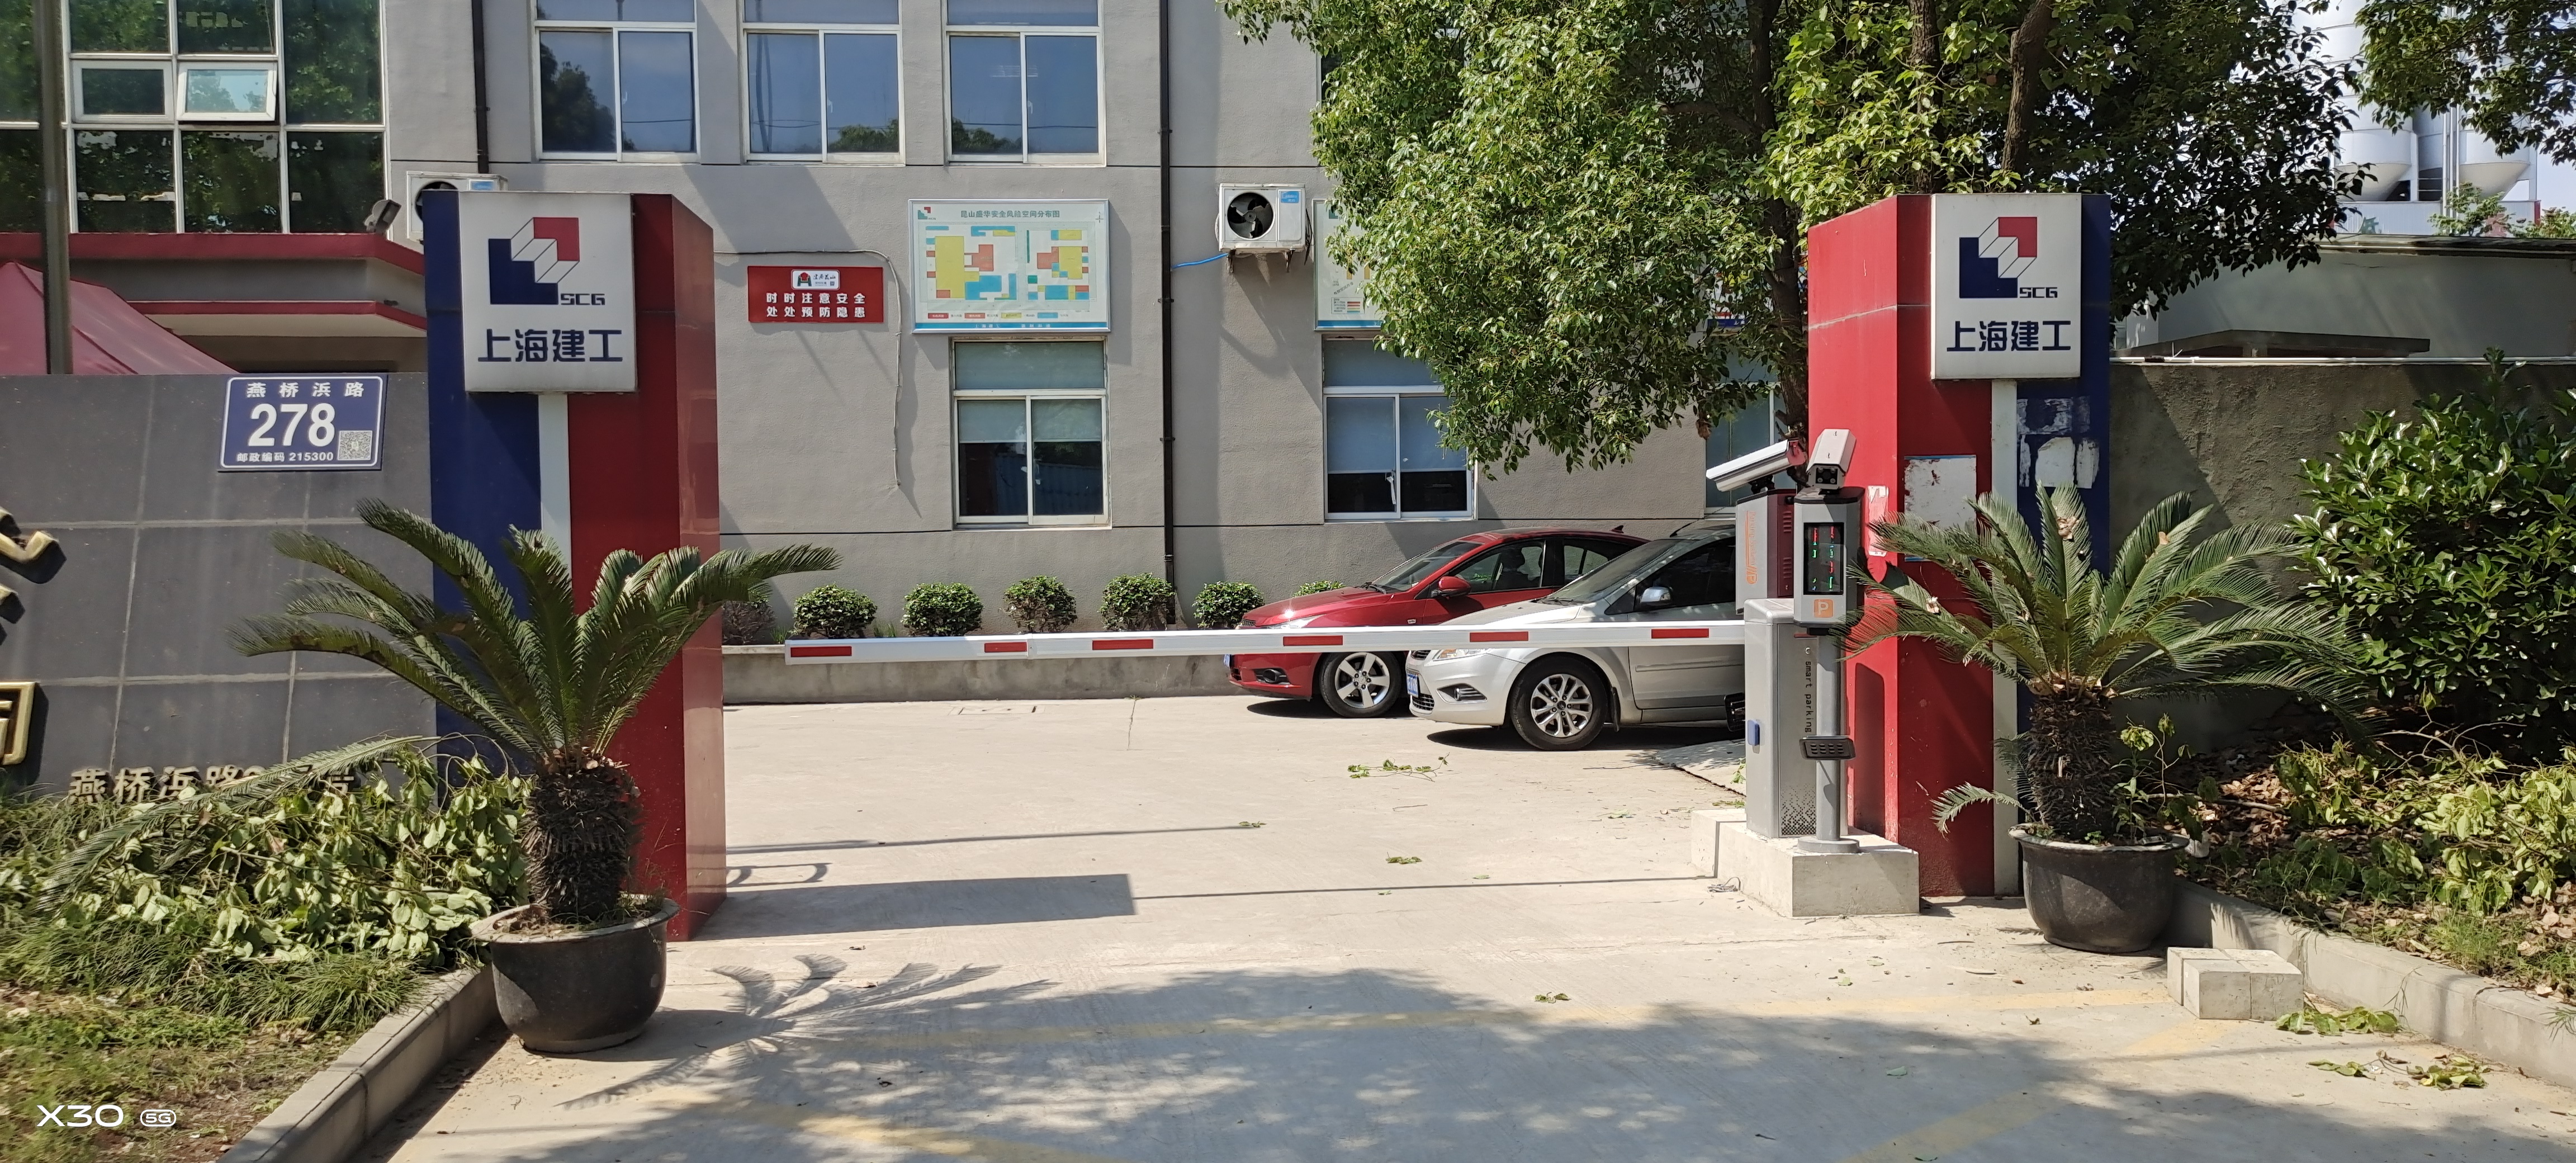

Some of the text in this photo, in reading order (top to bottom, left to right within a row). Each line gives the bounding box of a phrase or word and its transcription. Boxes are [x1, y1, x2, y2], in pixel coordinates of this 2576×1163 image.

[766, 292, 866, 304] 时时注意安全
[2019, 287, 2058, 298] SCG
[561, 293, 605, 305] SCG
[766, 306, 866, 318] 处处预防隐患
[1947, 320, 2071, 352] 上海建工
[478, 329, 623, 362] 上海建工
[247, 382, 364, 398] 燕桥浜路
[248, 403, 335, 447] 278
[236, 452, 334, 462] 邮政编码 215300
[1818, 602, 1829, 614] P
[1805, 694, 1813, 732] parking
